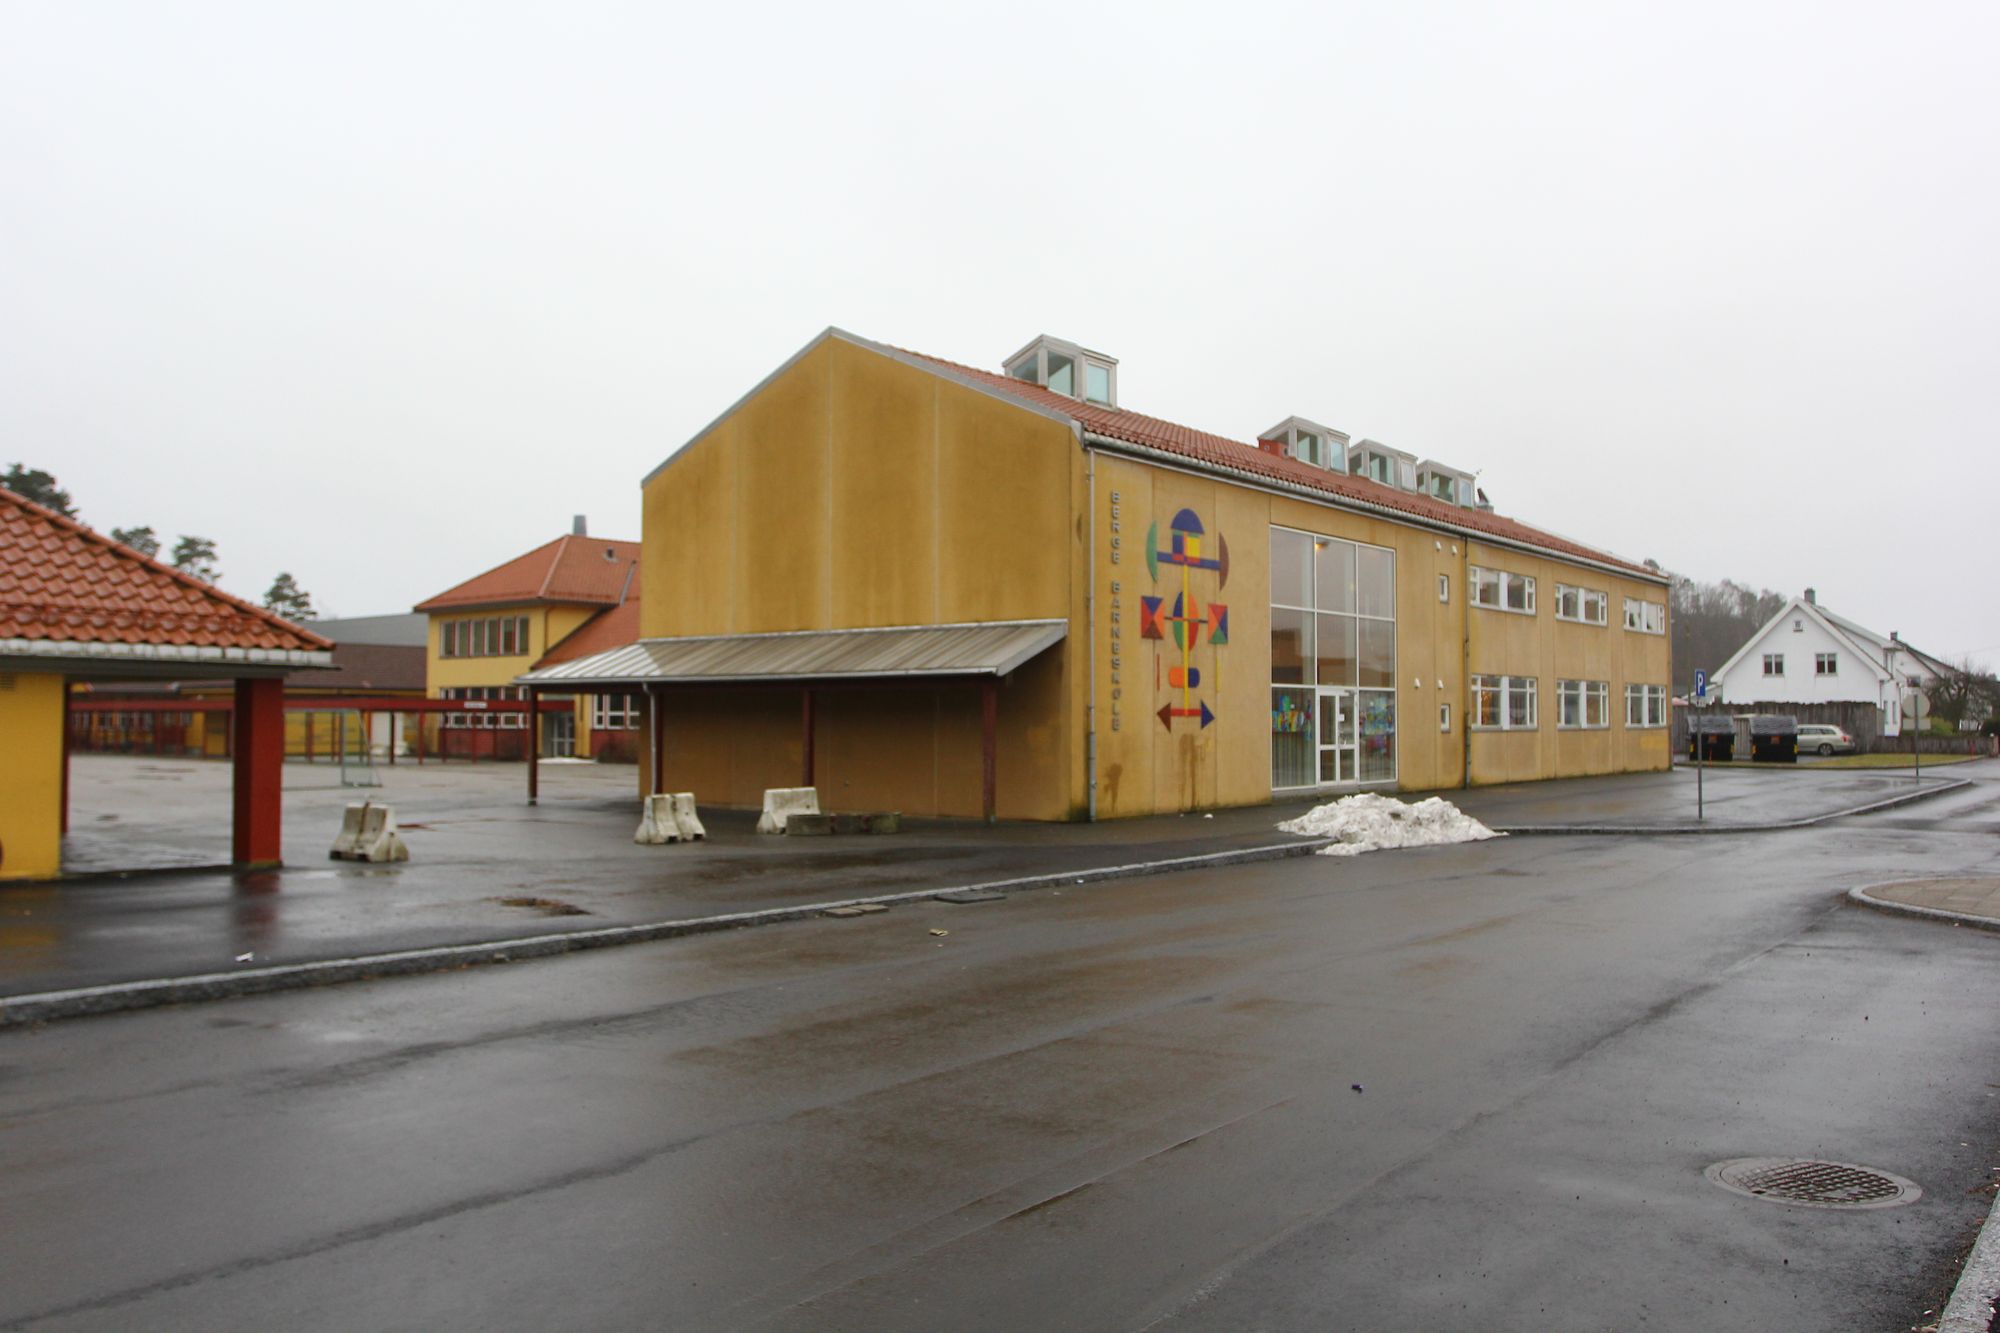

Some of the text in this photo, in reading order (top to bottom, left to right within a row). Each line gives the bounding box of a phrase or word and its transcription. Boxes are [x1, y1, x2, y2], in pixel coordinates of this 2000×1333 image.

[1111, 490, 1121, 731] BERGE BARNESKOLE
[1697, 672, 1704, 695] P
